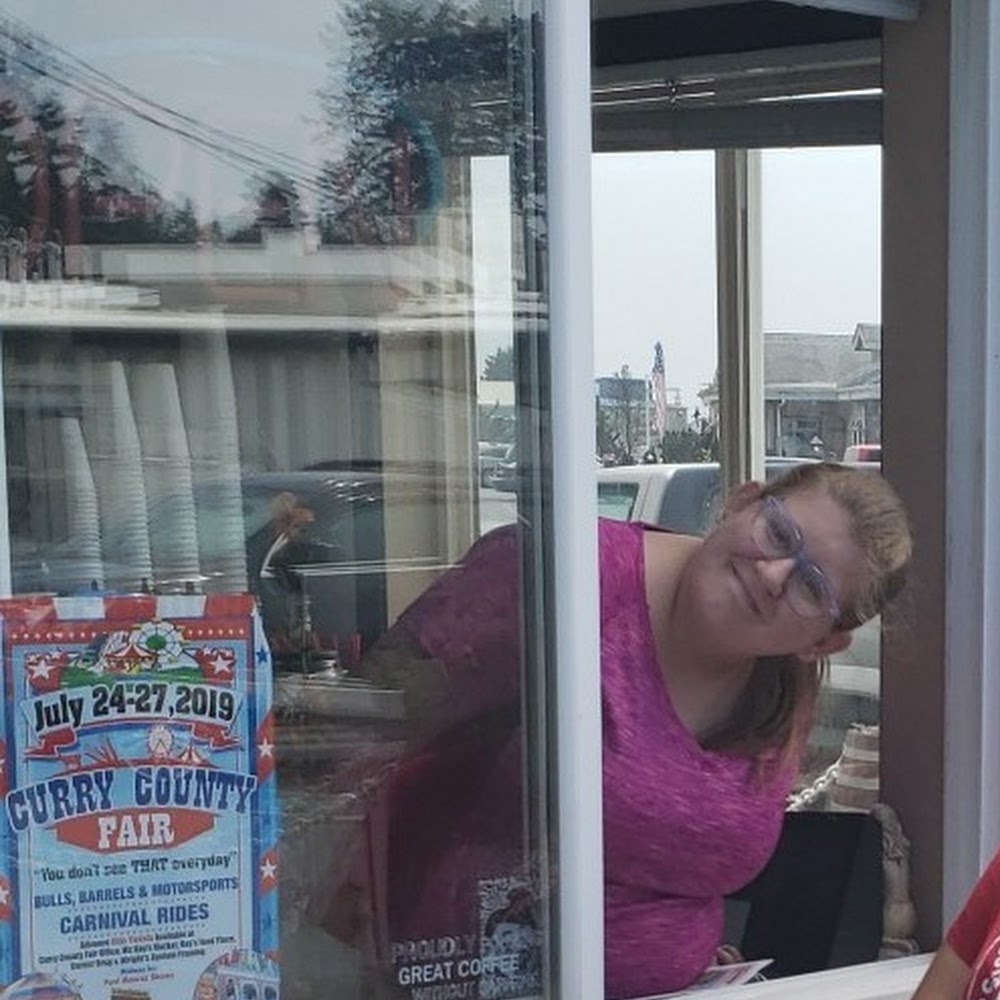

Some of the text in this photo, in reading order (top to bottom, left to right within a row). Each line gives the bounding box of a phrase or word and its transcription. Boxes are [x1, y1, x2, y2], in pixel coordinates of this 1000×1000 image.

[34, 683, 234, 732] July 24-27,2019
[8, 767, 255, 831] CURRY COUNTY
[98, 813, 175, 848] FAIR
[68, 864, 99, 879] don't
[131, 858, 168, 873] THAT
[34, 877, 239, 908] BULLS, BARRELS & MOTORSPORTS
[60, 903, 209, 934] CARNIVAL RIDES
[399, 954, 520, 985] GREAT COFFEE
